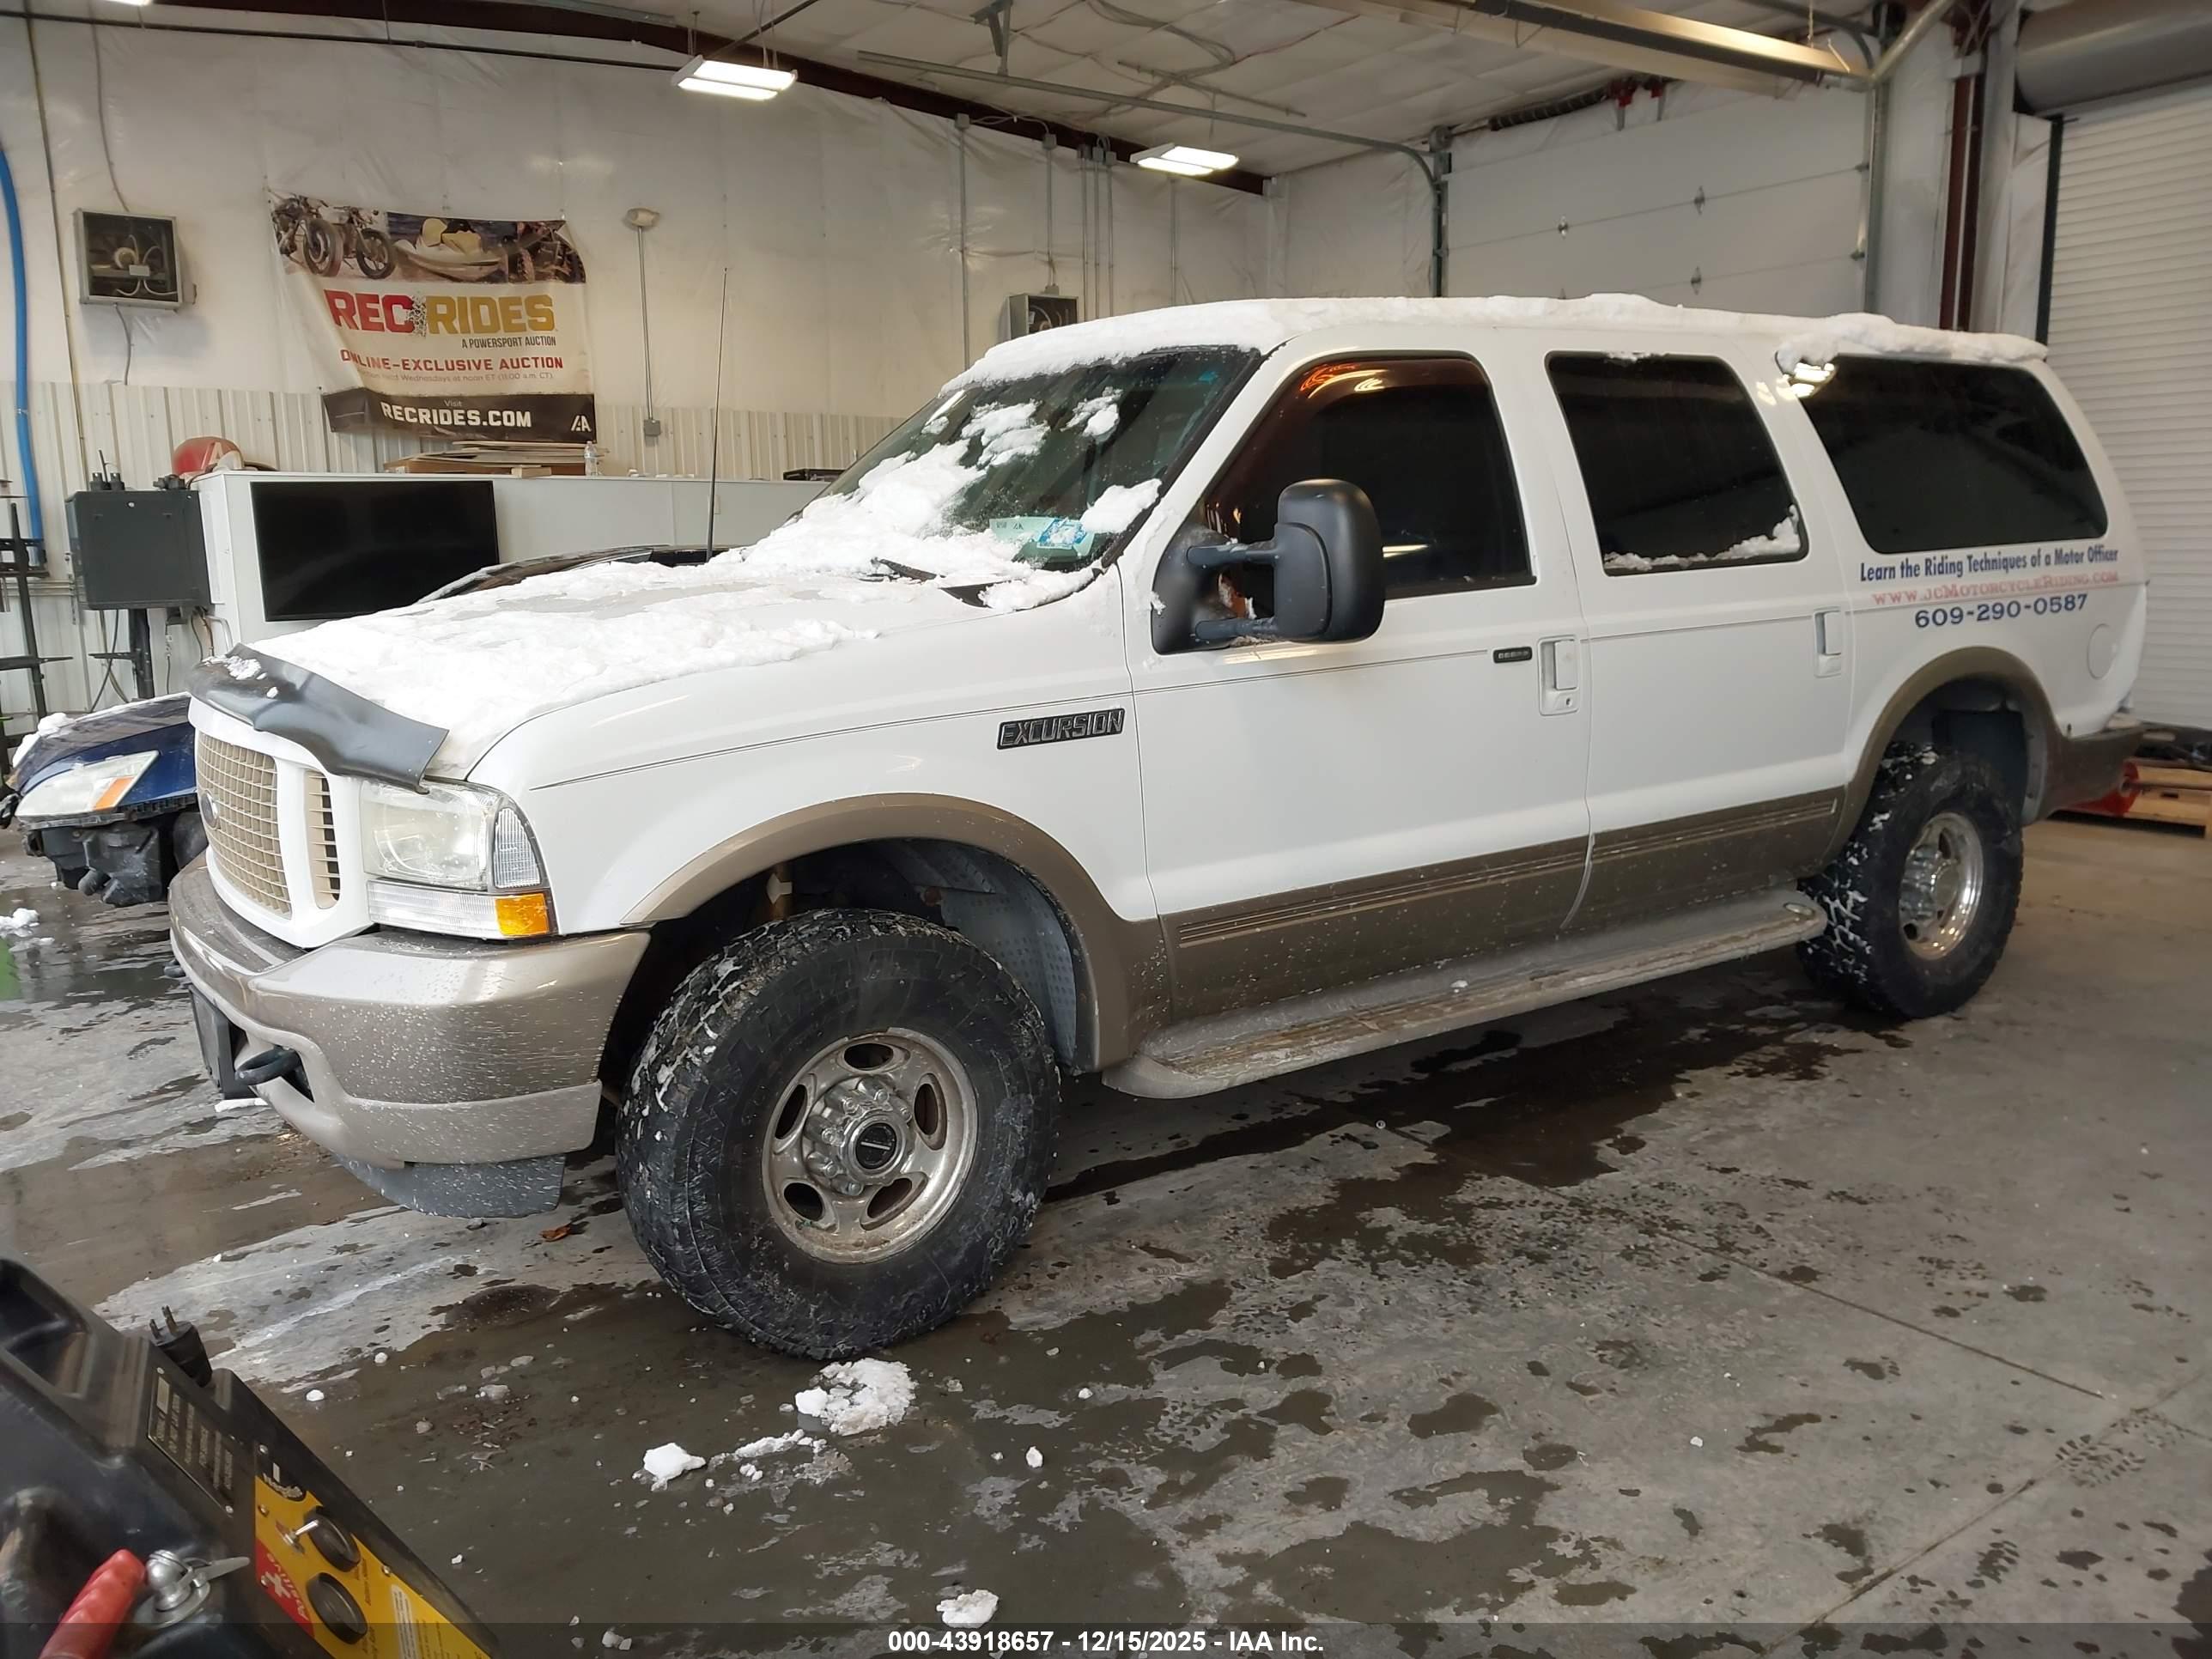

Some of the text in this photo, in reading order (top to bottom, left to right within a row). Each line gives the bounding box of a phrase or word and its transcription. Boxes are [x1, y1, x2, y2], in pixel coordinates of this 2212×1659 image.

[324, 289, 556, 336] REC RIDES
[462, 336, 556, 349] A POWERSPORT AUCTION
[340, 349, 563, 372] ONLINE-EXCLUSIVE AUCTION
[380, 401, 532, 428] RECRIDES.COM
[444, 399, 462, 408] Visit
[1860, 544, 2118, 582] Learn the Riding Techniques of a Motor Officer
[1915, 593, 2087, 628] 609-290-0587
[1000, 709, 1123, 746] EXCURSION
